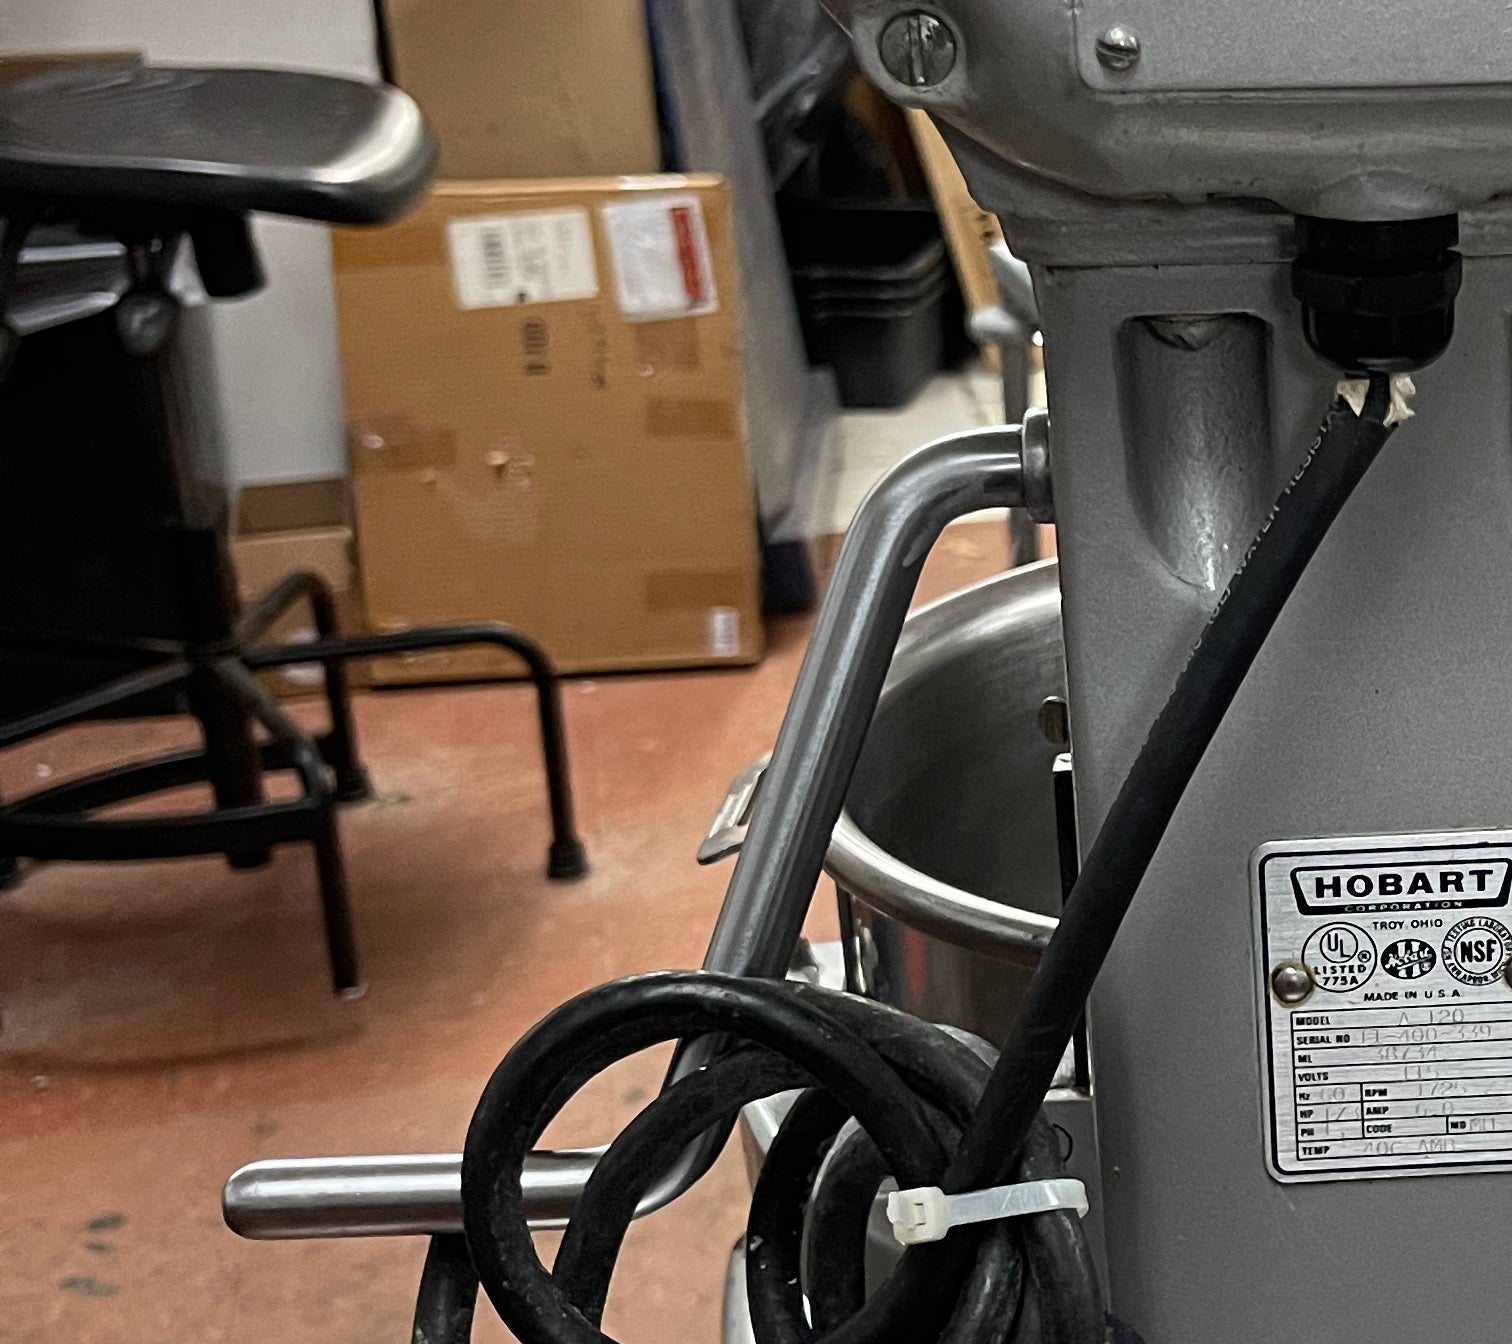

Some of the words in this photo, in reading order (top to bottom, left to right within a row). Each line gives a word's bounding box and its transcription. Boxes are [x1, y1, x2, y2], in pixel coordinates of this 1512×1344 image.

[1314, 869, 1494, 899] HOBART
[1344, 900, 1463, 913] CORPORATION
[1410, 918, 1444, 929] OHIO
[1327, 932, 1351, 959] UL
[1460, 939, 1498, 964] NSF
[1314, 964, 1367, 976] LISTED
[1363, 991, 1399, 1003] MADE
[1404, 990, 1419, 1001] IN
[1295, 1016, 1331, 1027] MODEL
[1296, 1034, 1332, 1046] SERIAL
[1298, 1071, 1329, 1083] VOLTS
[1364, 1087, 1388, 1098] RPM
[1299, 1109, 1314, 1119] HP
[1365, 1106, 1390, 1116] AMP
[1366, 1123, 1393, 1134] CODE
[1301, 1145, 1330, 1157] TEMP
